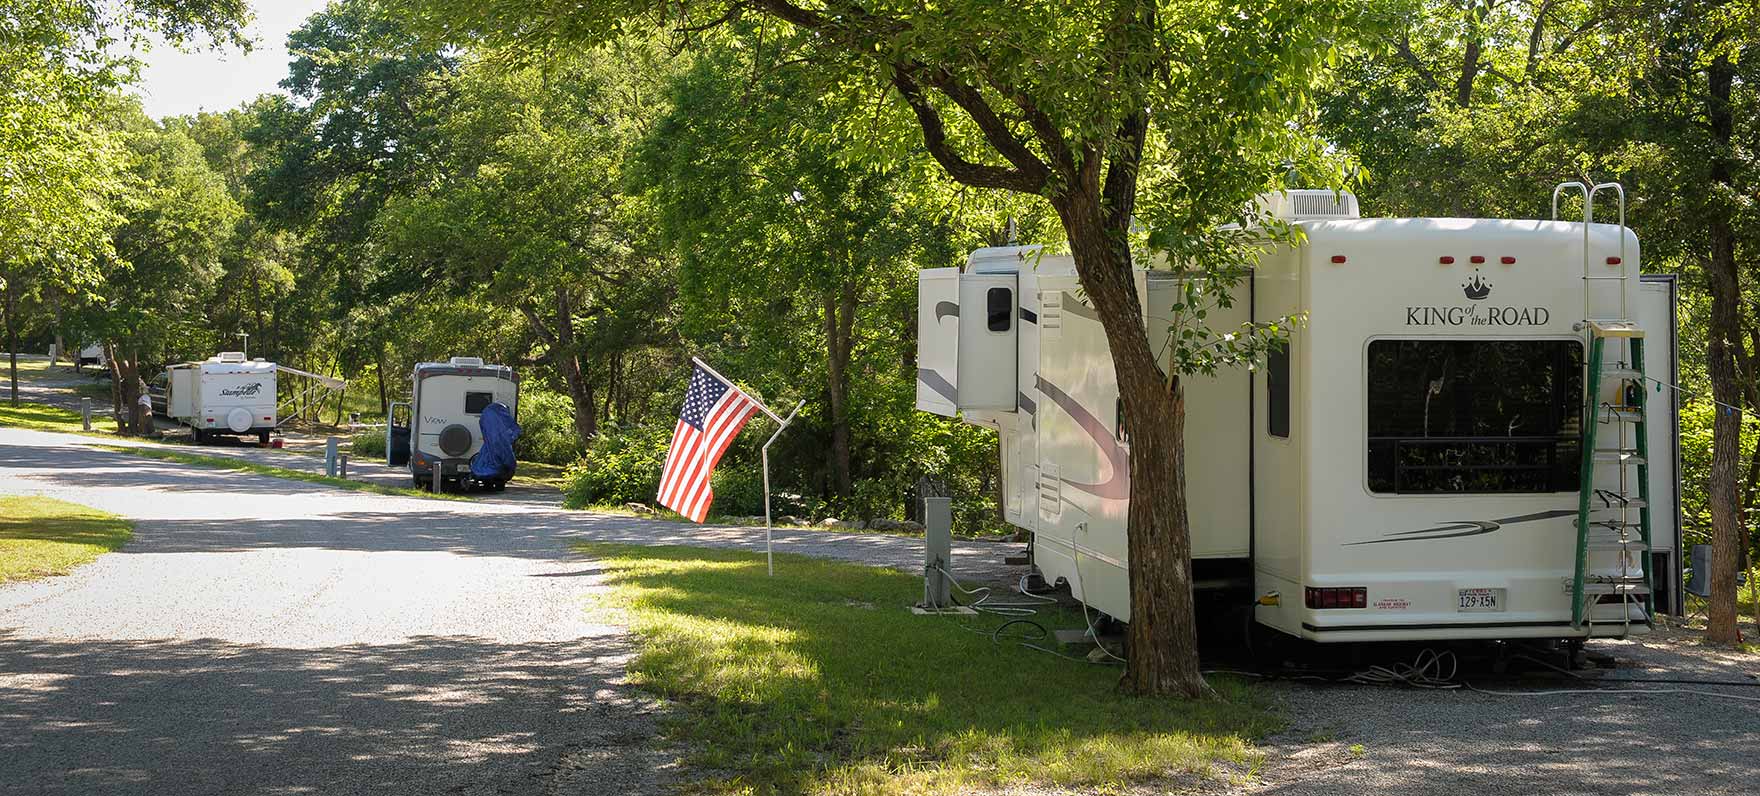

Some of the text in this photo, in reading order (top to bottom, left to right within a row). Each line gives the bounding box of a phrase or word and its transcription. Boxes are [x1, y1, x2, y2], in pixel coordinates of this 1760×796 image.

[1406, 304, 1550, 326] KING of the ROAD
